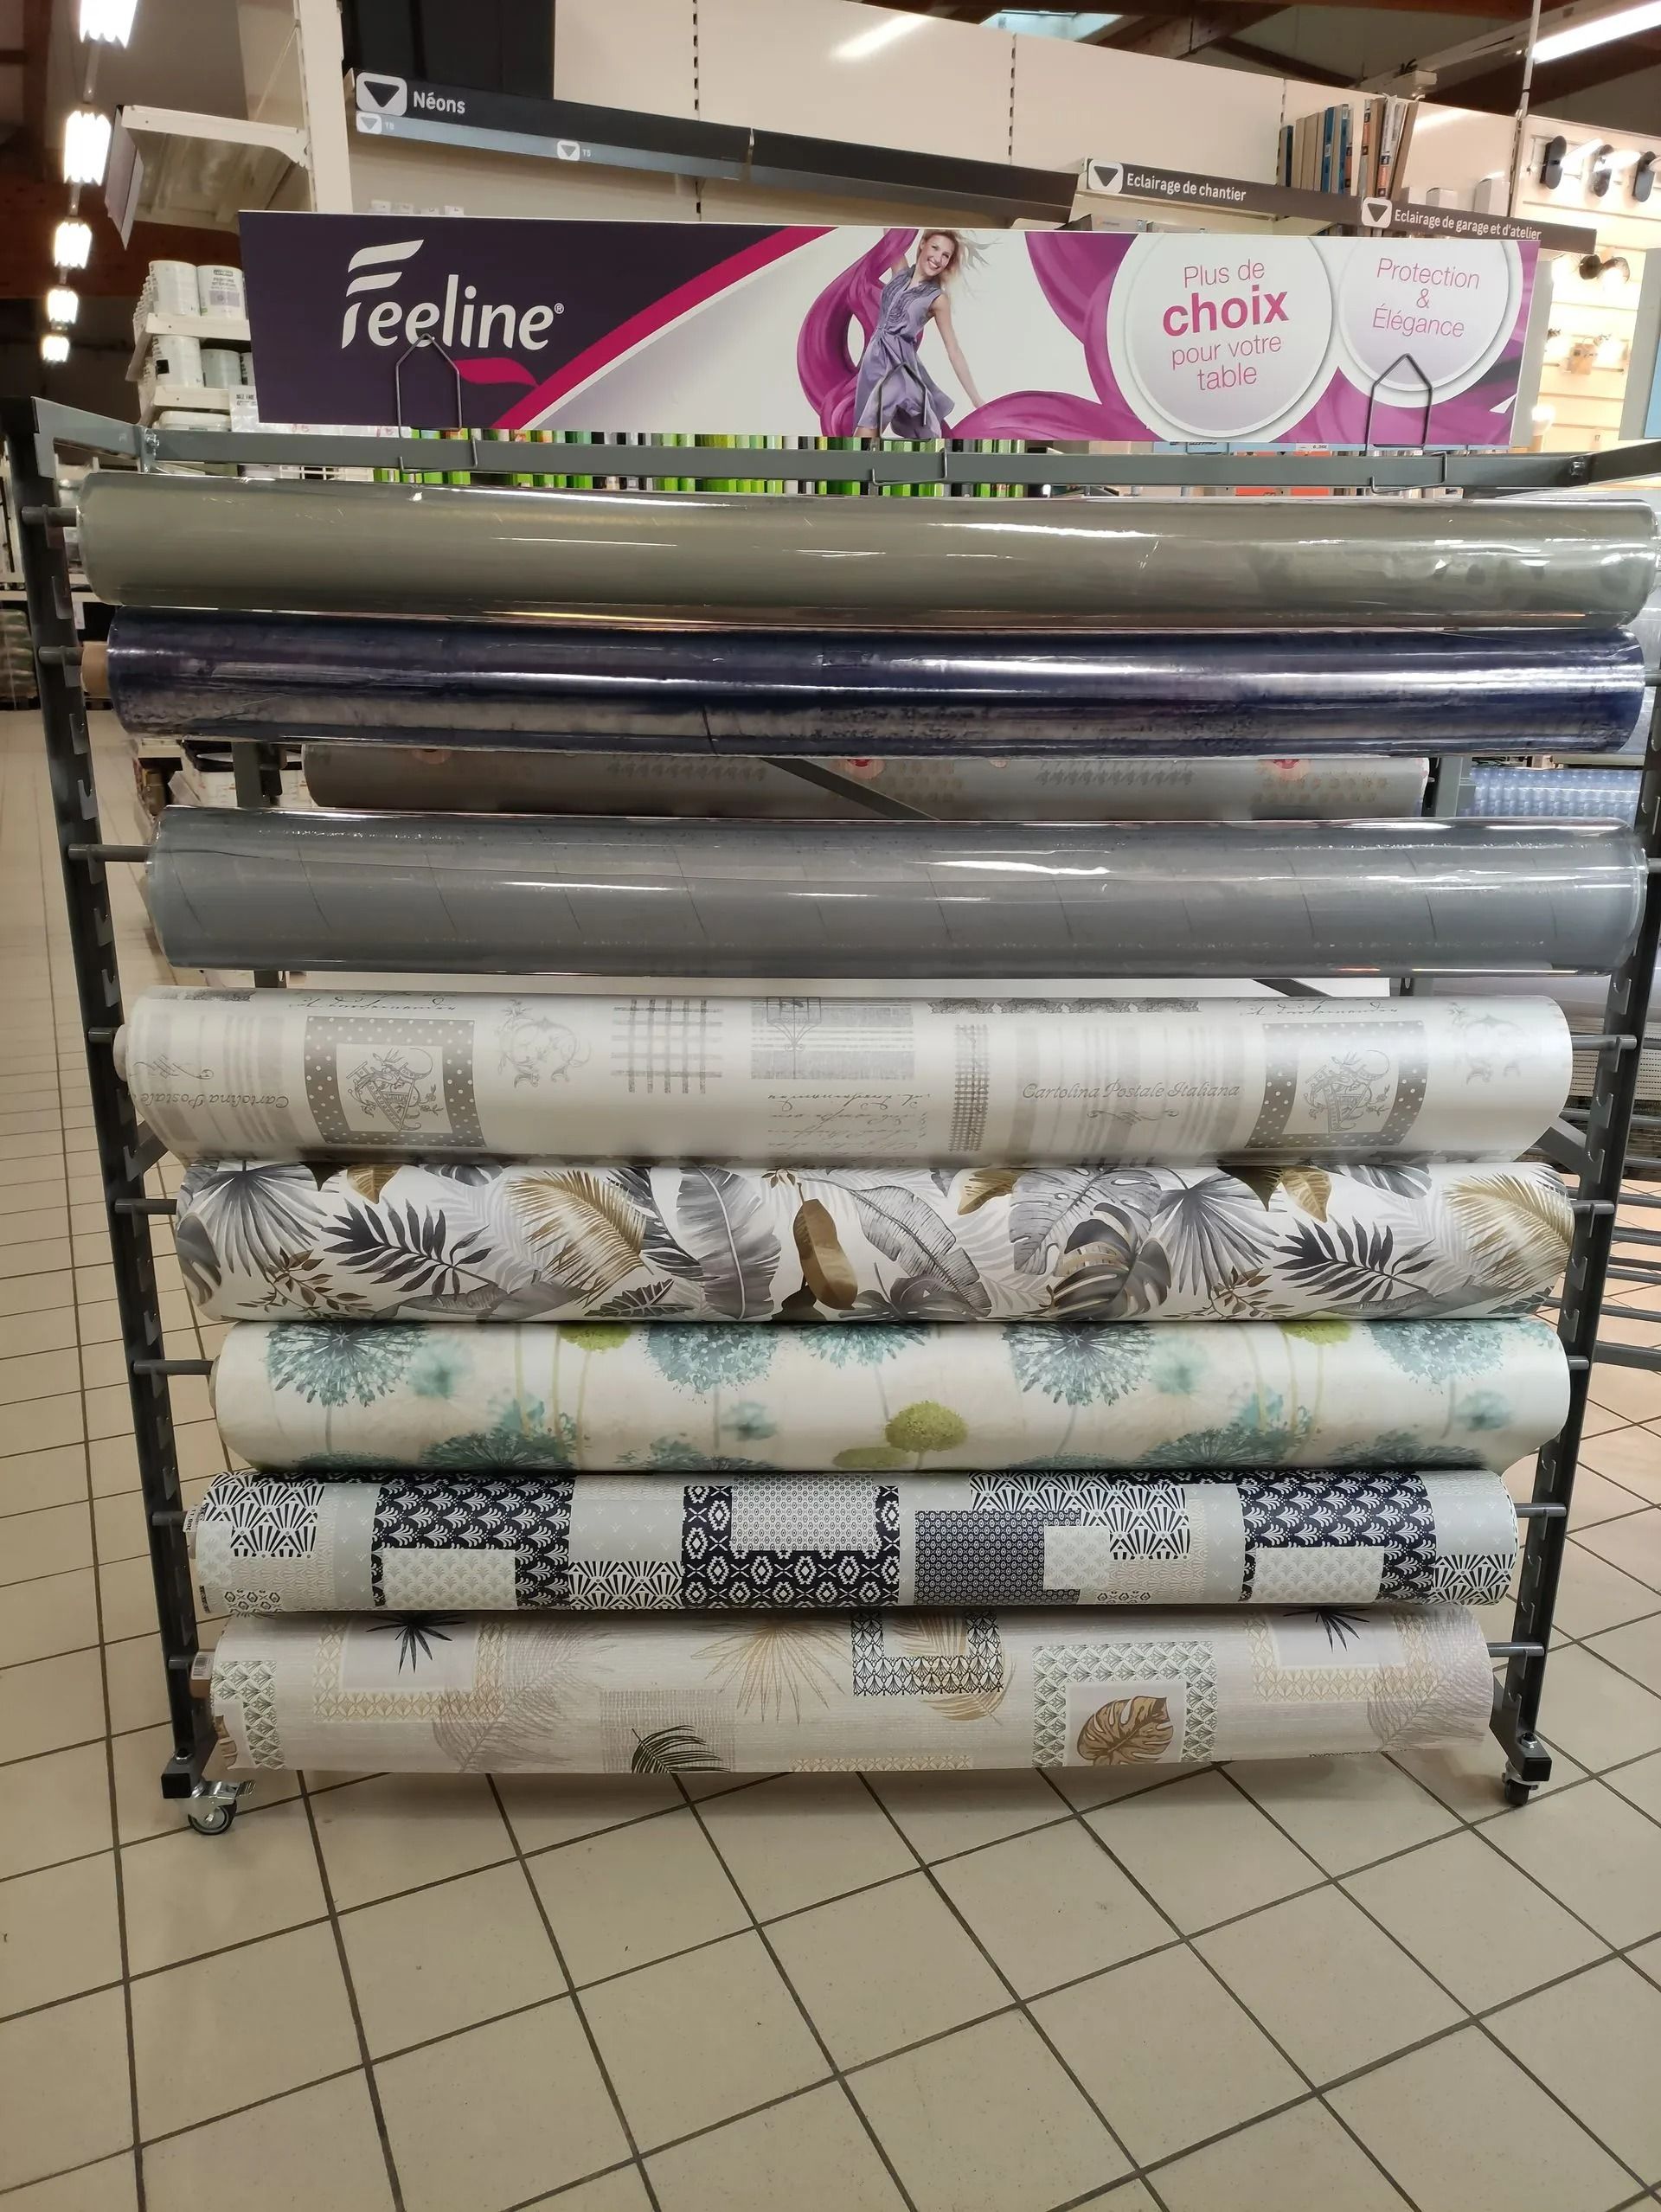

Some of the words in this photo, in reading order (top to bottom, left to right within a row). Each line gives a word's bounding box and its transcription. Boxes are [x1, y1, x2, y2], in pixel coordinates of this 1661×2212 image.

[414, 91, 465, 115] Néons
[1126, 173, 1181, 196] Eclairage
[1183, 181, 1196, 196] de
[1199, 184, 1247, 201] chantier
[1394, 209, 1440, 228] Eclairage
[1442, 215, 1454, 229] de
[1456, 220, 1489, 234] garage
[1490, 222, 1501, 235] et
[1503, 224, 1542, 240] d'atelier
[1184, 265, 1230, 288] Plus
[1238, 259, 1265, 281] de
[1376, 258, 1480, 290] Protection
[1163, 284, 1289, 337] choix
[1416, 288, 1429, 308] &
[1372, 303, 1465, 337] Élégance
[1171, 343, 1221, 371] pour
[1228, 335, 1281, 357] votre
[1196, 362, 1257, 391] table
[140, 1093, 205, 1109] Postale
[208, 1093, 290, 1109] Cartolina
[1022, 1082, 1100, 1100] Cartolina
[1102, 1079, 1165, 1099] Postale
[1166, 1081, 1240, 1099] Italiana
